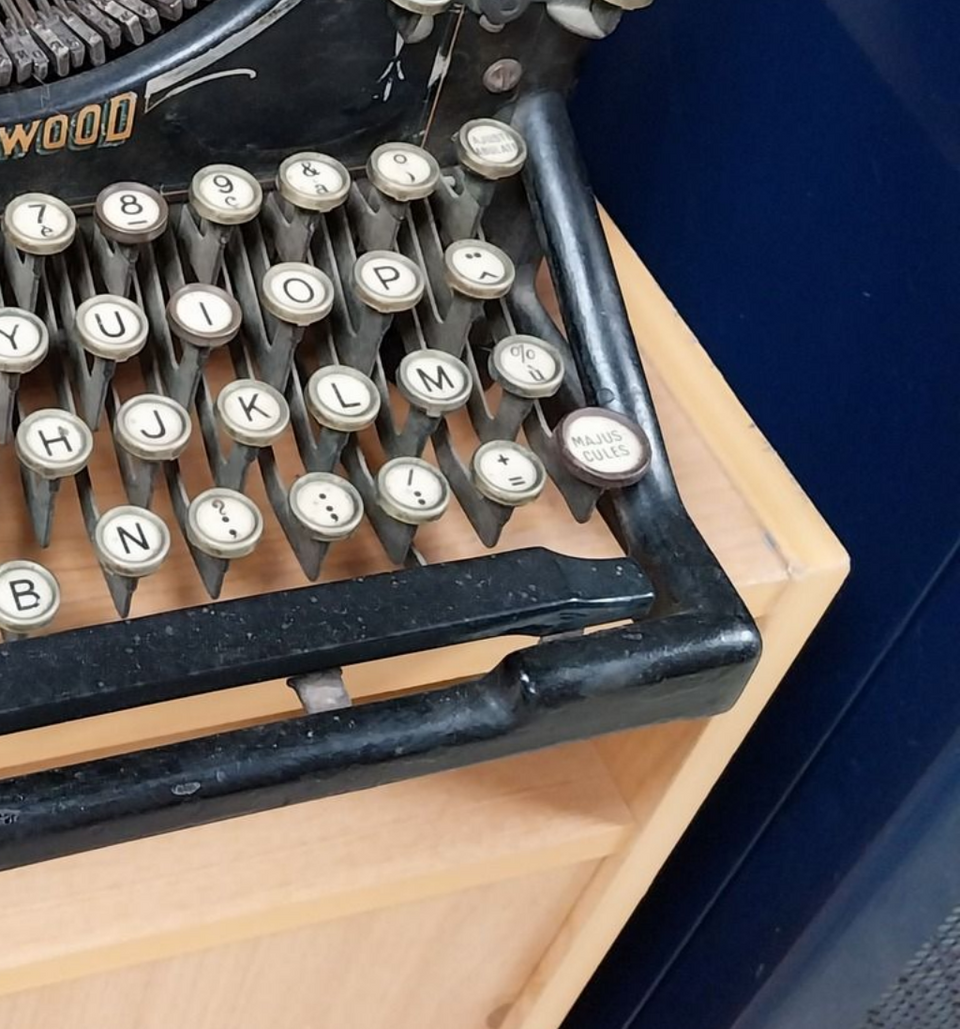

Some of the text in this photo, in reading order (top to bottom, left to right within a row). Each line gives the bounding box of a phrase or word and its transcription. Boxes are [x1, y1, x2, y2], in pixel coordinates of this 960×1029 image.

[301, 161, 321, 177] &
[213, 174, 234, 193] 9
[28, 203, 46, 224] 7
[119, 194, 144, 215] 8
[283, 277, 315, 303] O
[372, 265, 401, 291] P
[94, 310, 126, 338] U
[199, 301, 213, 326] I
[510, 344, 536, 364] %
[415, 364, 455, 393] M
[238, 392, 272, 422] K
[331, 381, 362, 409] L
[140, 409, 166, 439] J
[38, 428, 73, 457] H
[571, 429, 622, 447] MAJUS
[497, 454, 510, 466] +
[582, 444, 630, 462] CULES
[508, 476, 526, 486] =
[211, 499, 230, 523] ?
[116, 522, 151, 555] N
[9, 578, 41, 612] B
